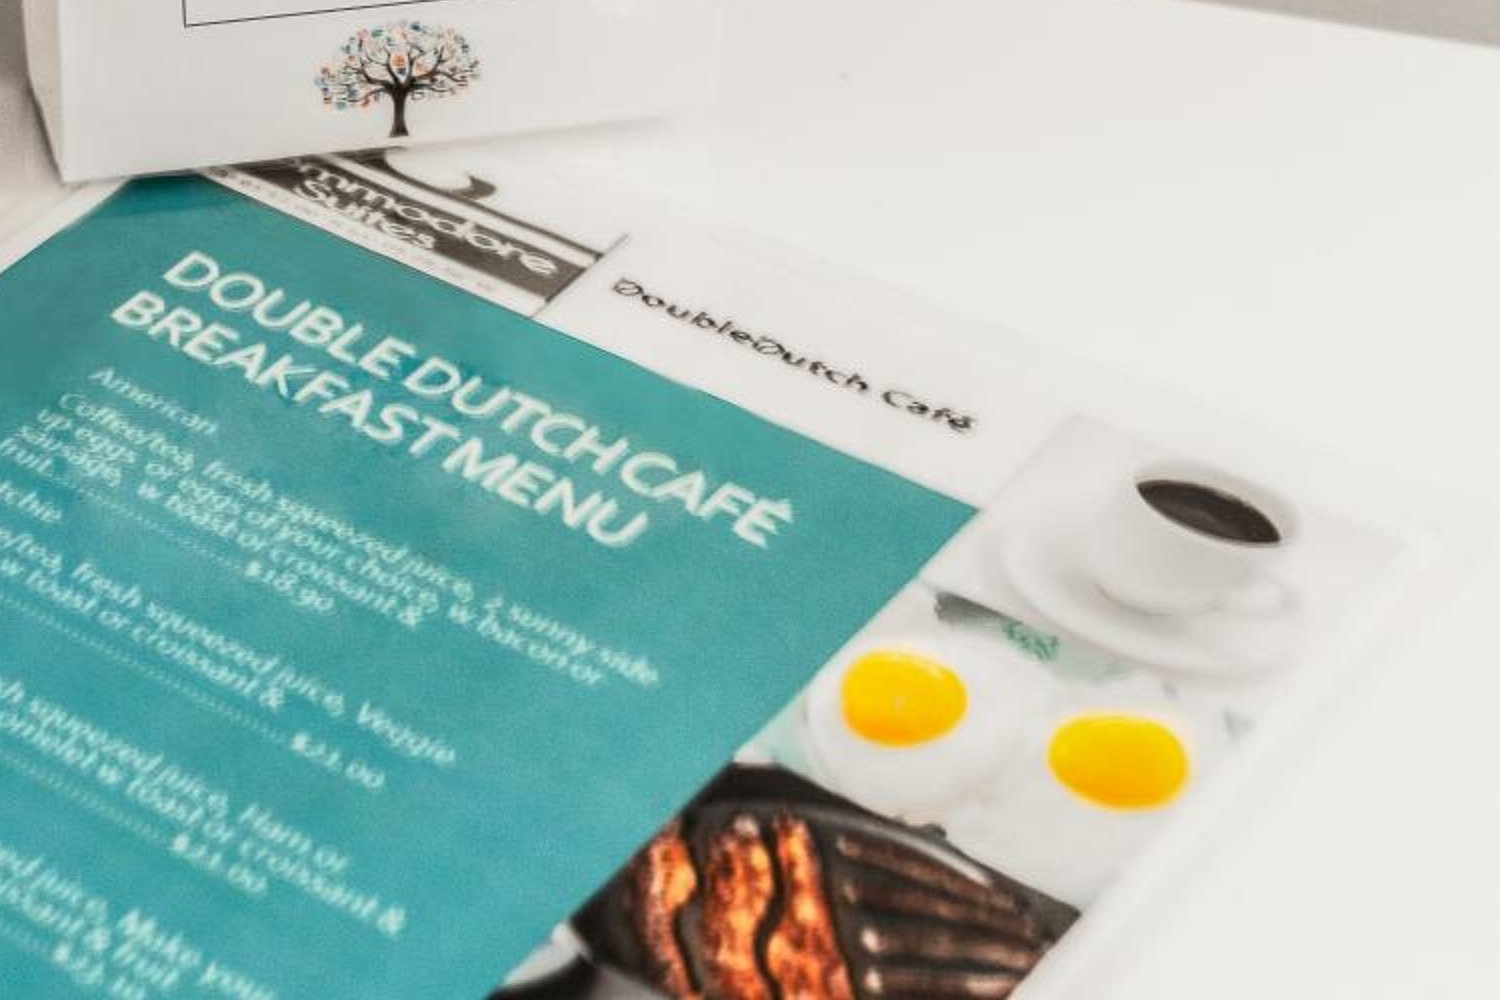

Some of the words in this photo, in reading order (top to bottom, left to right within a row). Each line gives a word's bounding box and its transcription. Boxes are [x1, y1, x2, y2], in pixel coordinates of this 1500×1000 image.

[293, 178, 437, 251] Suites
[88, 367, 219, 438] American
[163, 250, 417, 383] DOUBLE
[391, 355, 629, 473] DUTCH
[620, 451, 794, 548] CAFÉ
[611, 277, 870, 393] DoubleDutch
[882, 388, 979, 433] Café
[110, 290, 460, 457] BREAKFAST
[441, 438, 649, 547] MENU
[61, 427, 148, 470] eggs
[166, 476, 253, 524] eggs
[475, 610, 583, 670] bacon
[163, 494, 238, 537] toast
[25, 569, 99, 615] toast
[65, 560, 142, 608] fresh
[146, 601, 281, 679] squeezed
[197, 459, 285, 506] fresh
[272, 495, 409, 564] squeezed
[493, 603, 597, 660] sunny
[595, 646, 659, 688] side
[28, 695, 165, 779] squeezed
[230, 802, 312, 854] Ham
[127, 775, 206, 826] toast
[110, 940, 183, 988] fruit
[117, 908, 202, 967] Make
